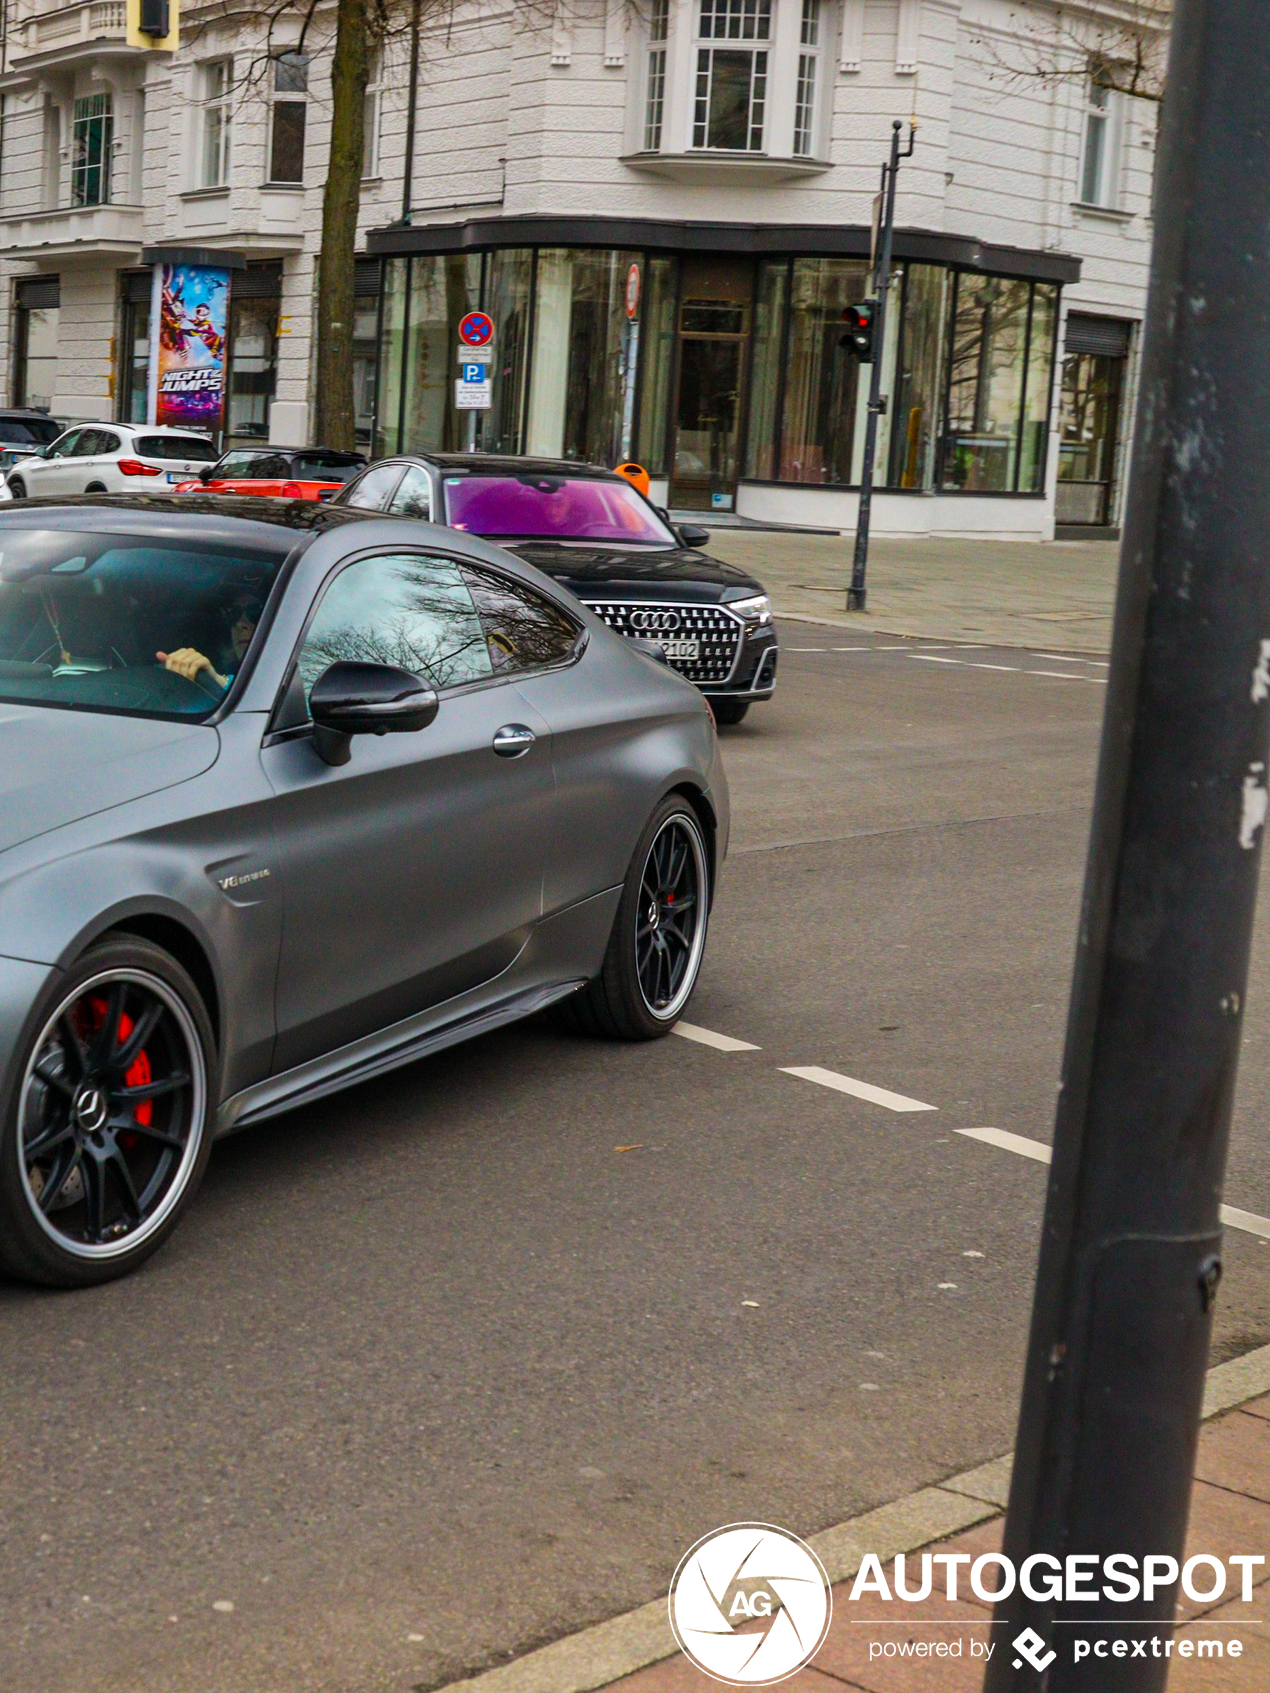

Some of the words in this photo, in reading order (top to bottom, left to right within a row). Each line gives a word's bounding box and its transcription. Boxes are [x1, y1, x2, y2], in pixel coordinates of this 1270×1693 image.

[162, 369, 214, 382] NIGHT
[467, 365, 479, 381] P
[158, 378, 222, 392] JUMPS
